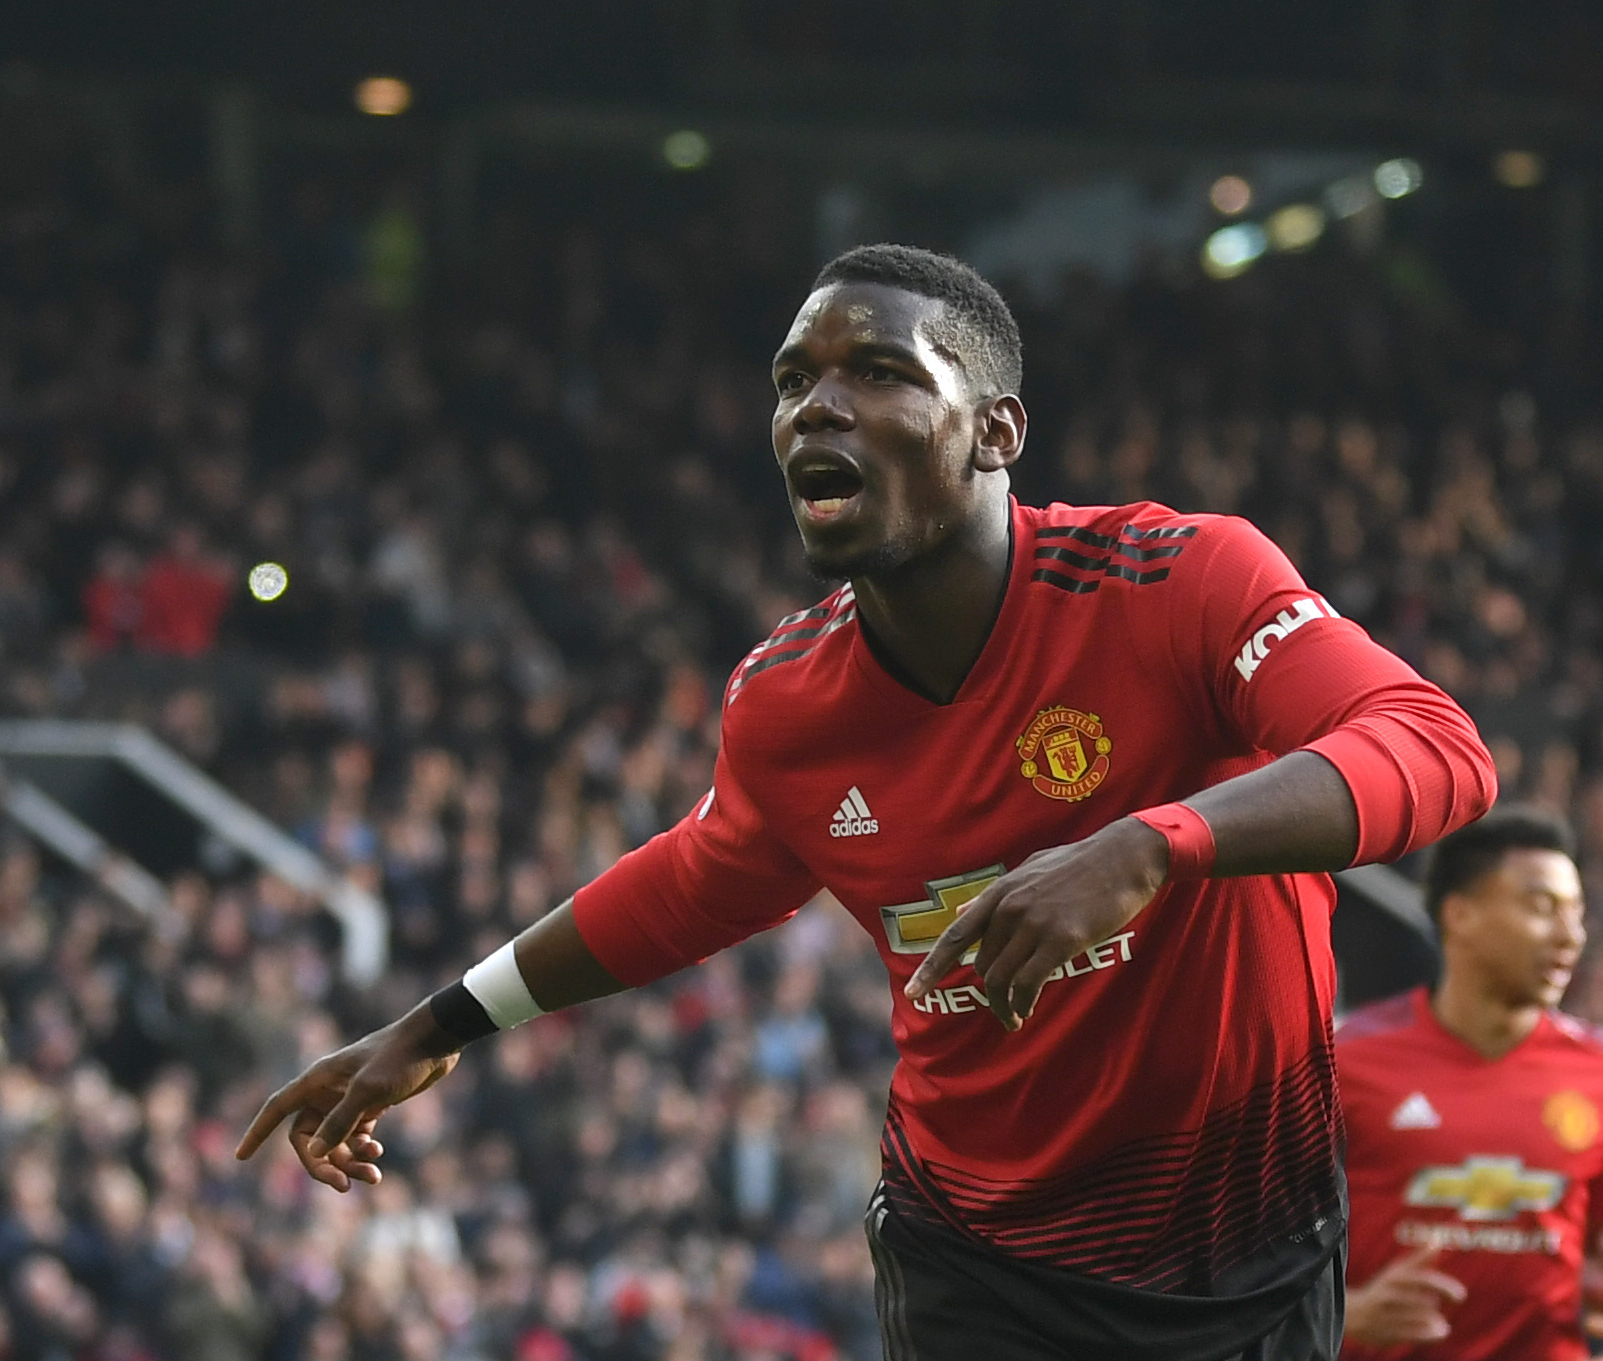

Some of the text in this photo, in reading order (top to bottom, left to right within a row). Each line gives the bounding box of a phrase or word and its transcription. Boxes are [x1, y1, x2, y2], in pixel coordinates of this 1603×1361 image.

[1023, 712, 1097, 753] MANCHESTER
[1051, 771, 1101, 797] UNITED
[829, 817, 879, 838] adidas
